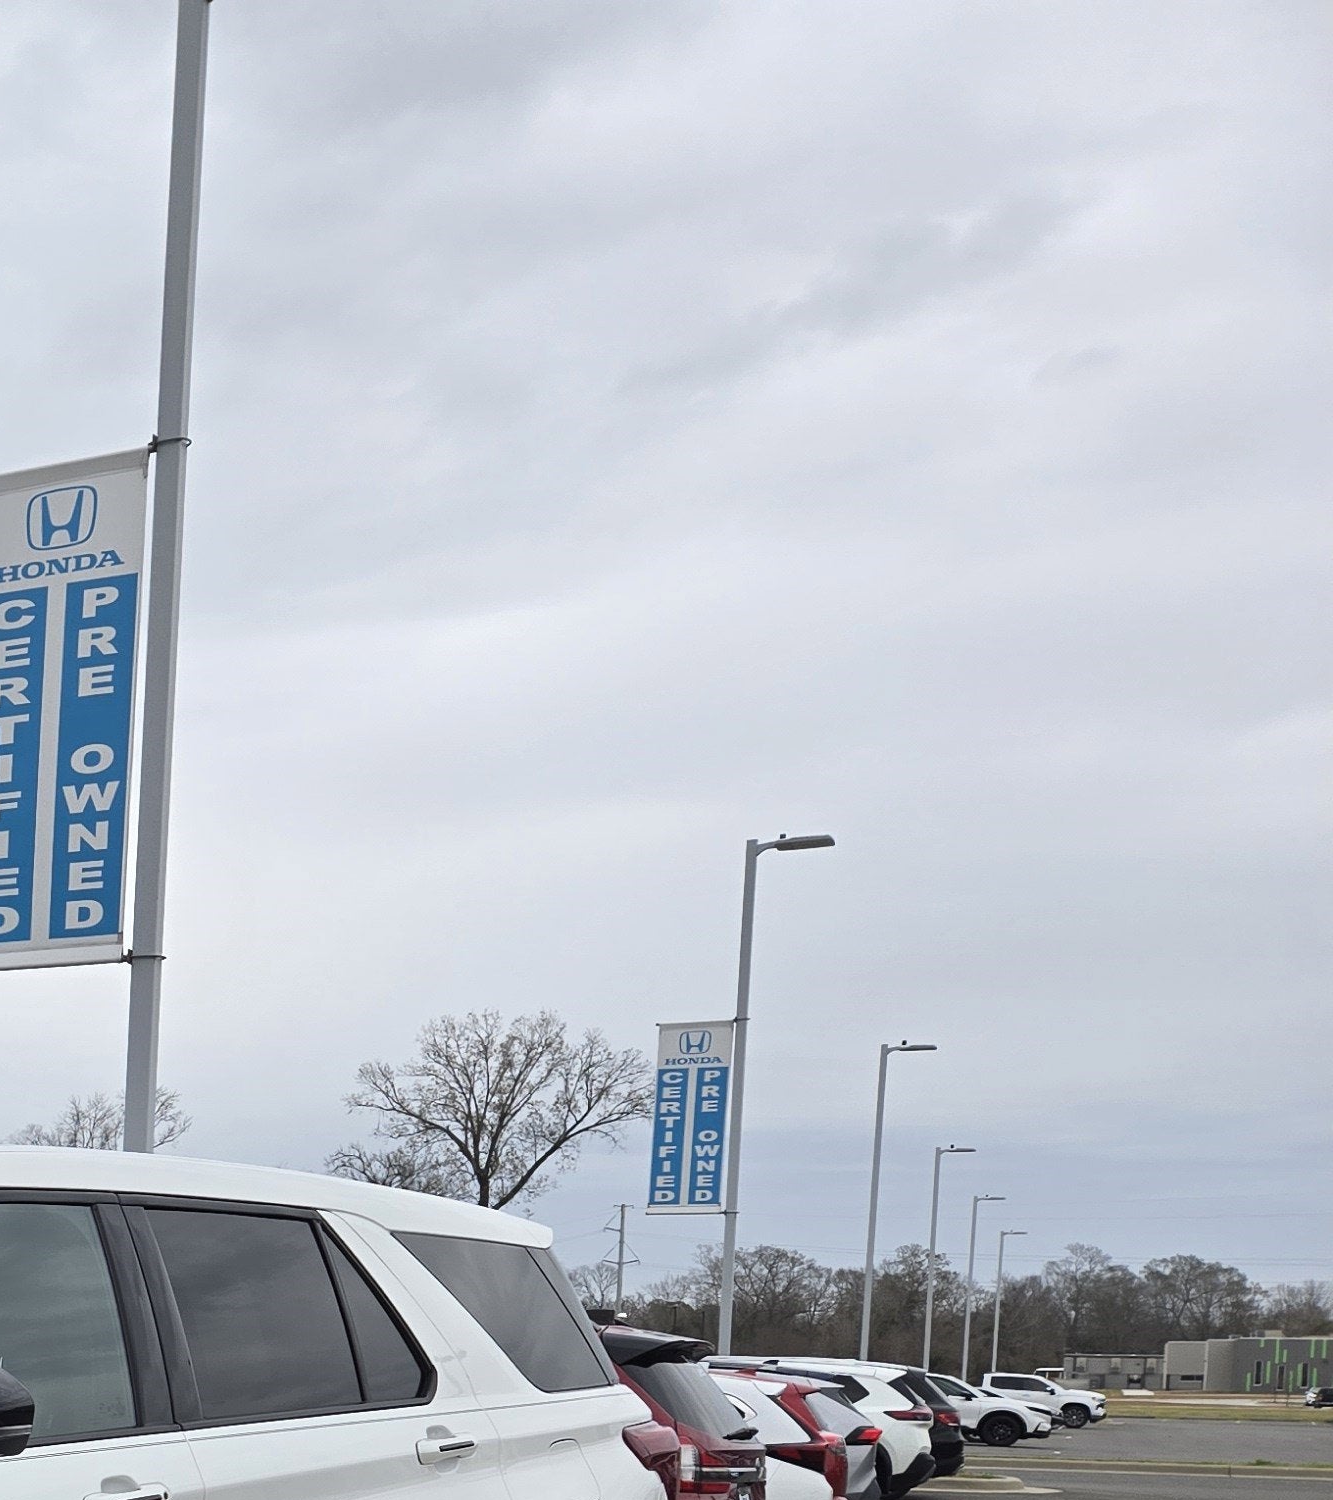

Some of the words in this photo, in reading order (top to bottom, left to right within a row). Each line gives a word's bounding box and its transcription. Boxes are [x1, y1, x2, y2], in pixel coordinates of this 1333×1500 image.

[76, 585, 120, 698] PRE
[61, 742, 121, 932] OWNED
[664, 1056, 723, 1066] HONDA
[701, 1070, 721, 1113] PRE
[653, 1071, 684, 1203] CERTIFIED
[694, 1130, 720, 1202] OWNED
